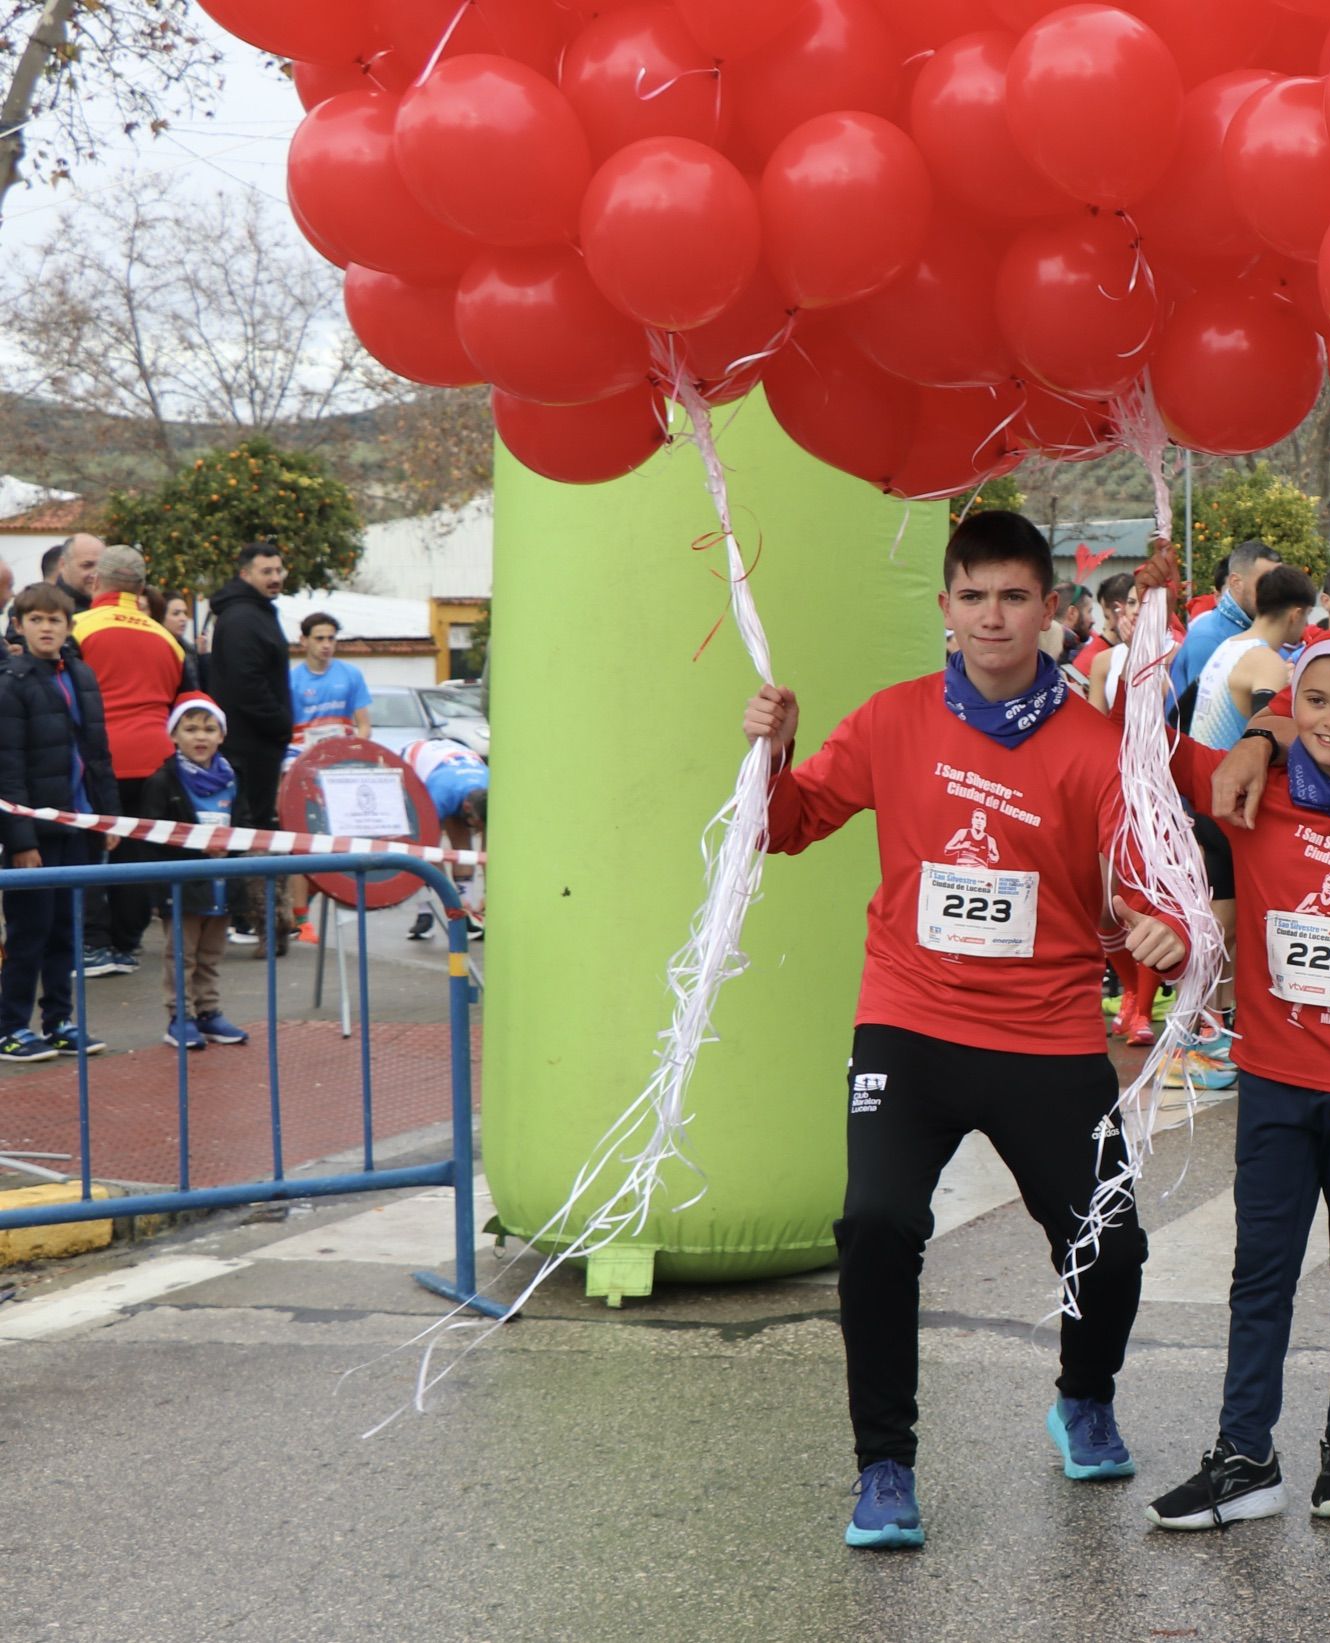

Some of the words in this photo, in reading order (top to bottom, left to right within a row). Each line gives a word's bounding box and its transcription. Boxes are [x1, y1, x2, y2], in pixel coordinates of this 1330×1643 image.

[934, 762, 943, 776] I
[943, 764, 965, 782] San
[966, 772, 1013, 800] Silvestre
[947, 781, 986, 806] Ciudad
[985, 793, 1000, 811] de
[1000, 798, 1041, 828] Lucena
[1294, 824, 1303, 837] I
[1302, 827, 1324, 847] San
[942, 894, 1012, 923] 223
[853, 1091, 869, 1100] Club
[851, 1105, 878, 1114] Lucena
